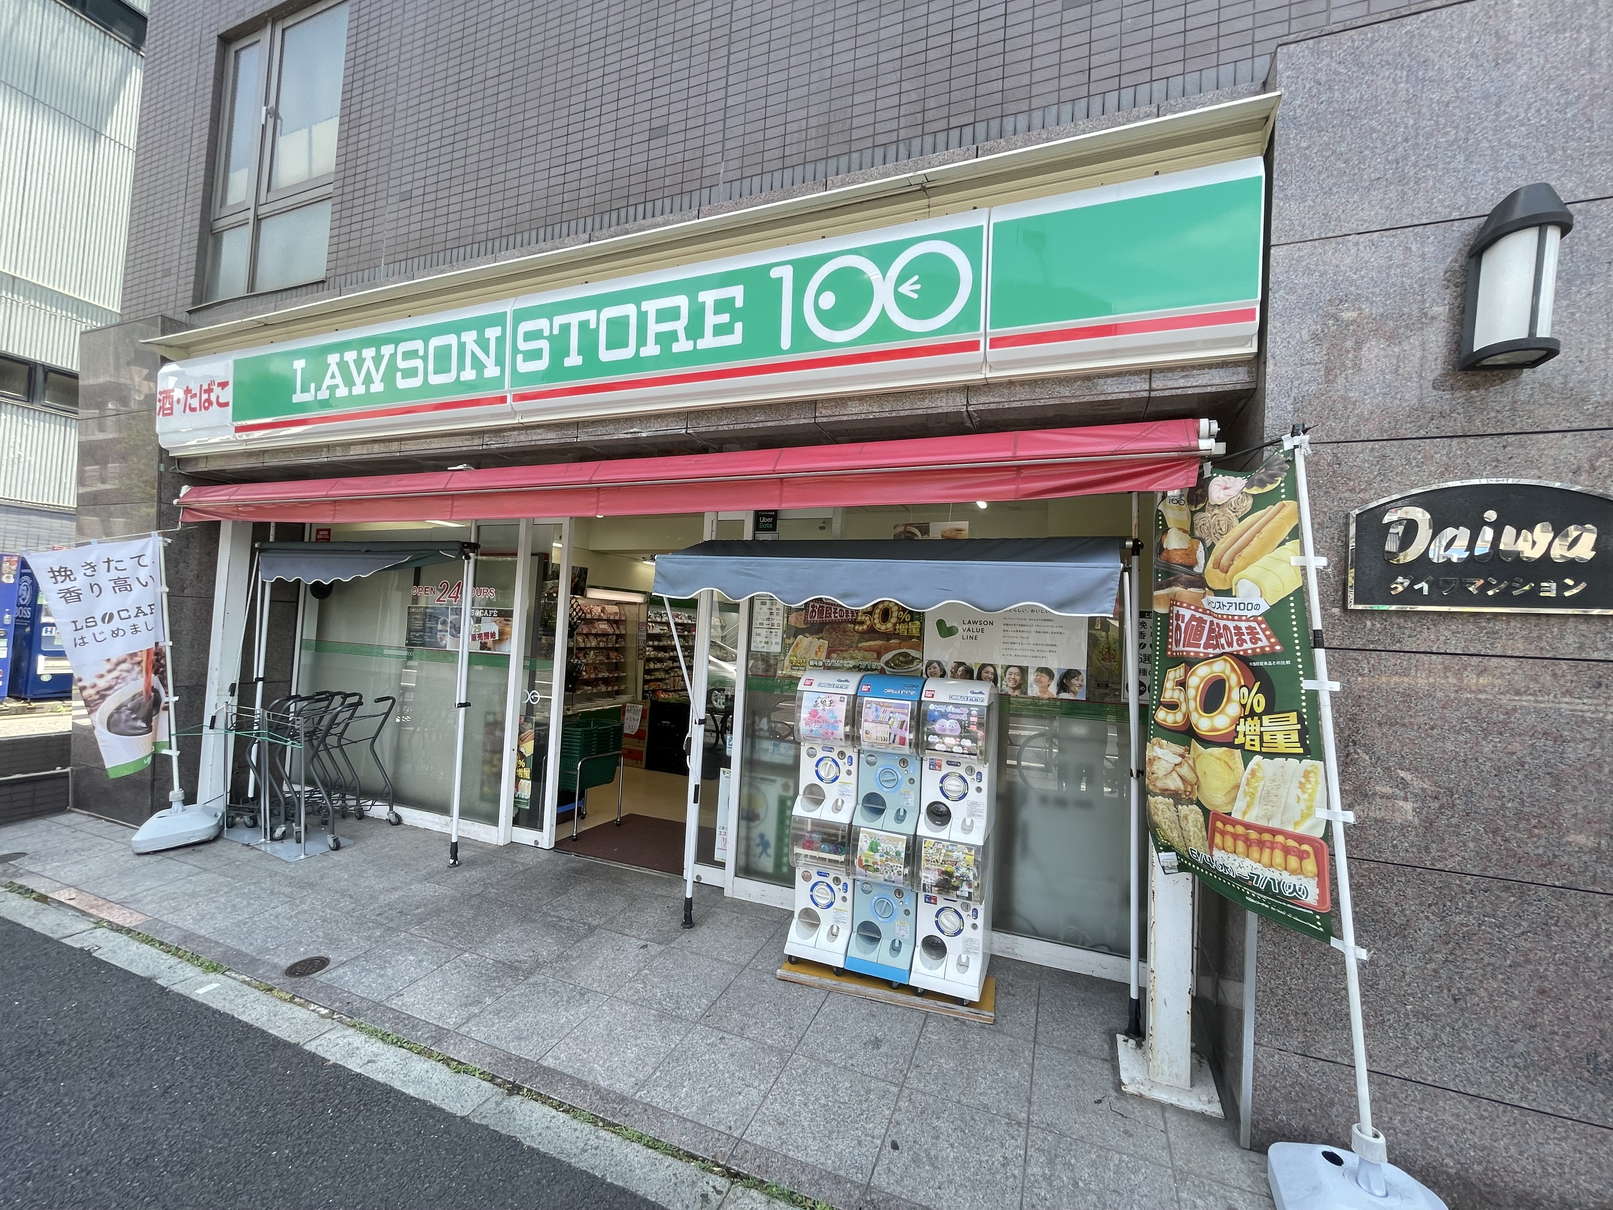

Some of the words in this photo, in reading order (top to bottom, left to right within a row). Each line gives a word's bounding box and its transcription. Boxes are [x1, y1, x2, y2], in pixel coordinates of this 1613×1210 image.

[292, 326, 501, 403] LAWSON
[516, 285, 744, 373] STORE
[770, 240, 973, 351] 100
[157, 378, 230, 417] 酒・たばこ
[1382, 506, 1598, 563] Daiwa
[57, 575, 155, 604] 香り高い
[412, 585, 437, 596] OPEN
[435, 580, 463, 603] 24
[471, 587, 496, 599] OURS
[1389, 575, 1587, 598] ダイワマンション
[854, 600, 911, 632] 50%
[962, 619, 994, 627] LAWSON
[1154, 655, 1266, 736] 50%
[1234, 712, 1304, 753] 増量
